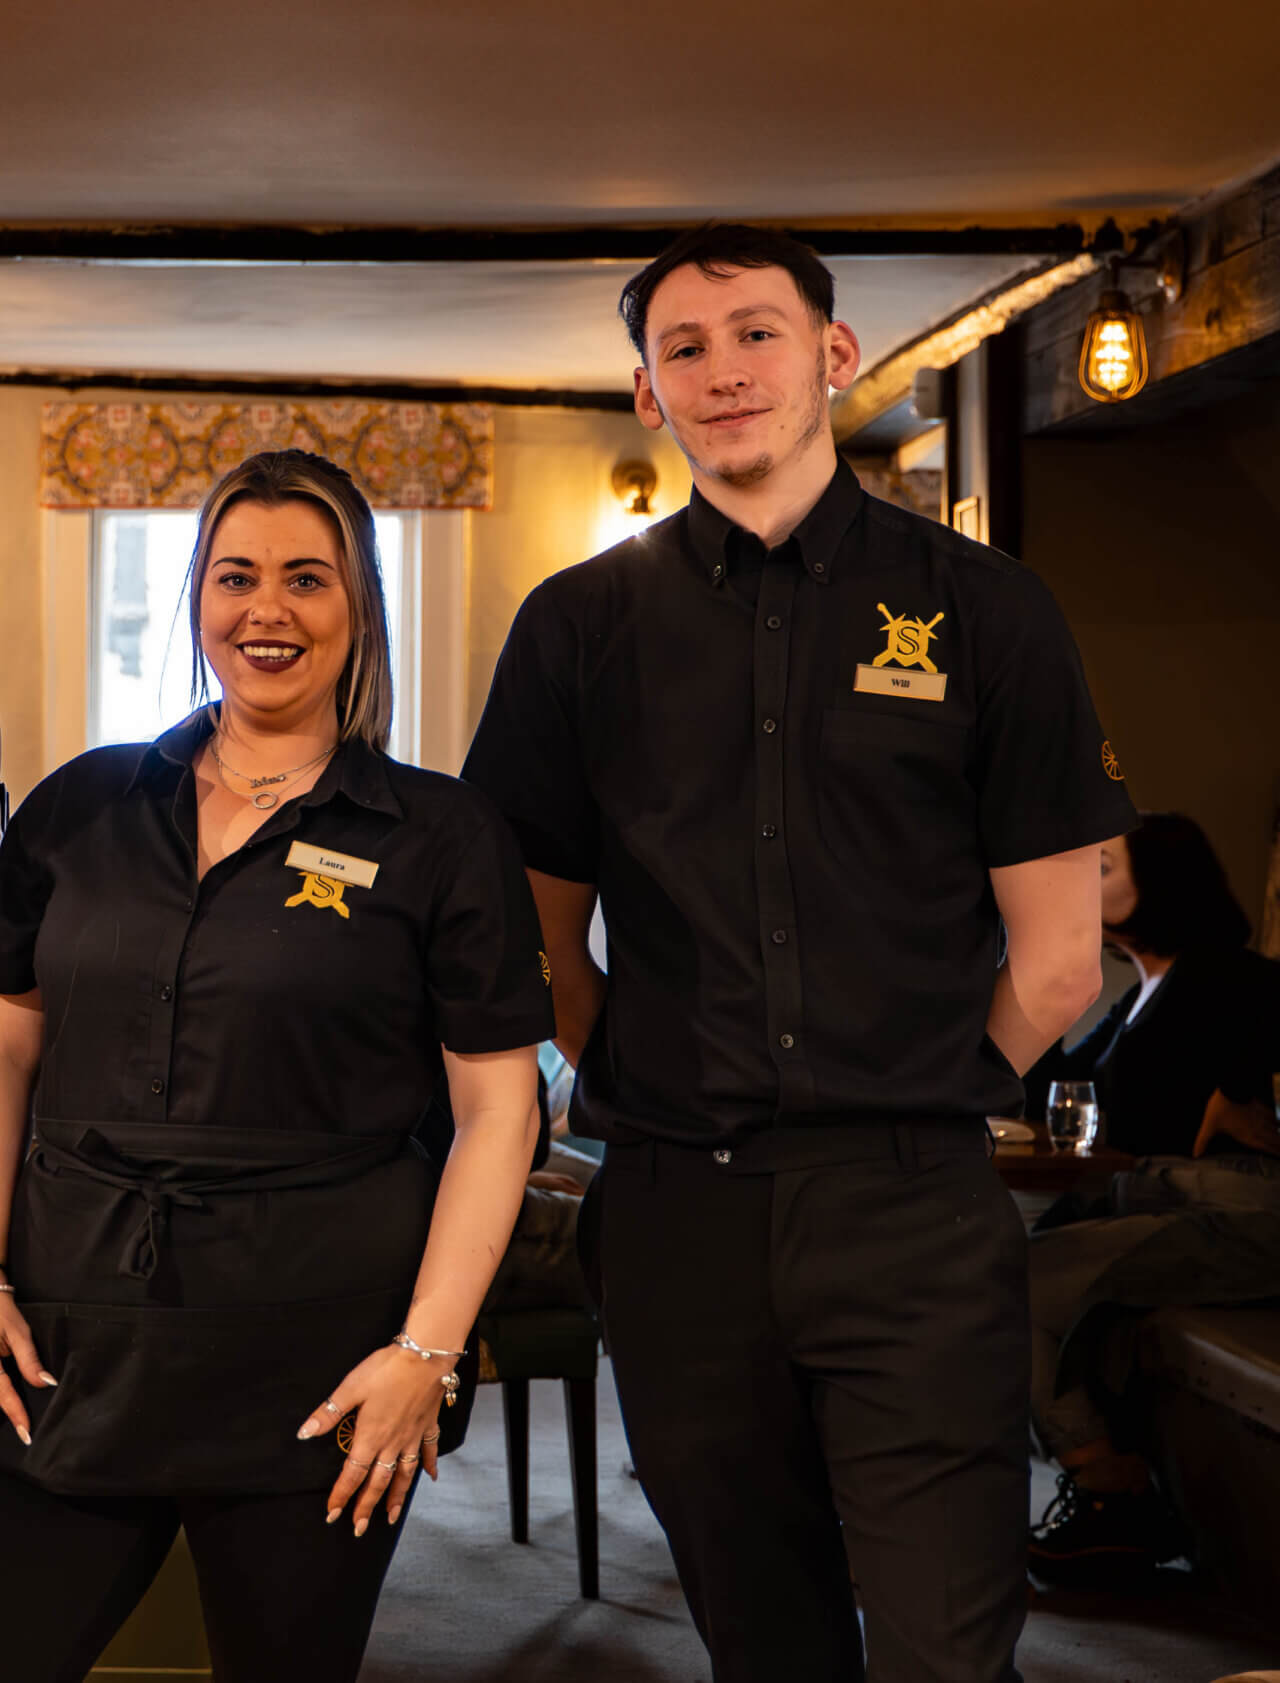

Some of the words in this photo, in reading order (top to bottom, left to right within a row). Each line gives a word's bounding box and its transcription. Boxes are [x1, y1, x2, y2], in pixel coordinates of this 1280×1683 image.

[897, 626, 920, 656] S
[891, 678, 910, 688] Will
[319, 856, 345, 871] Laura
